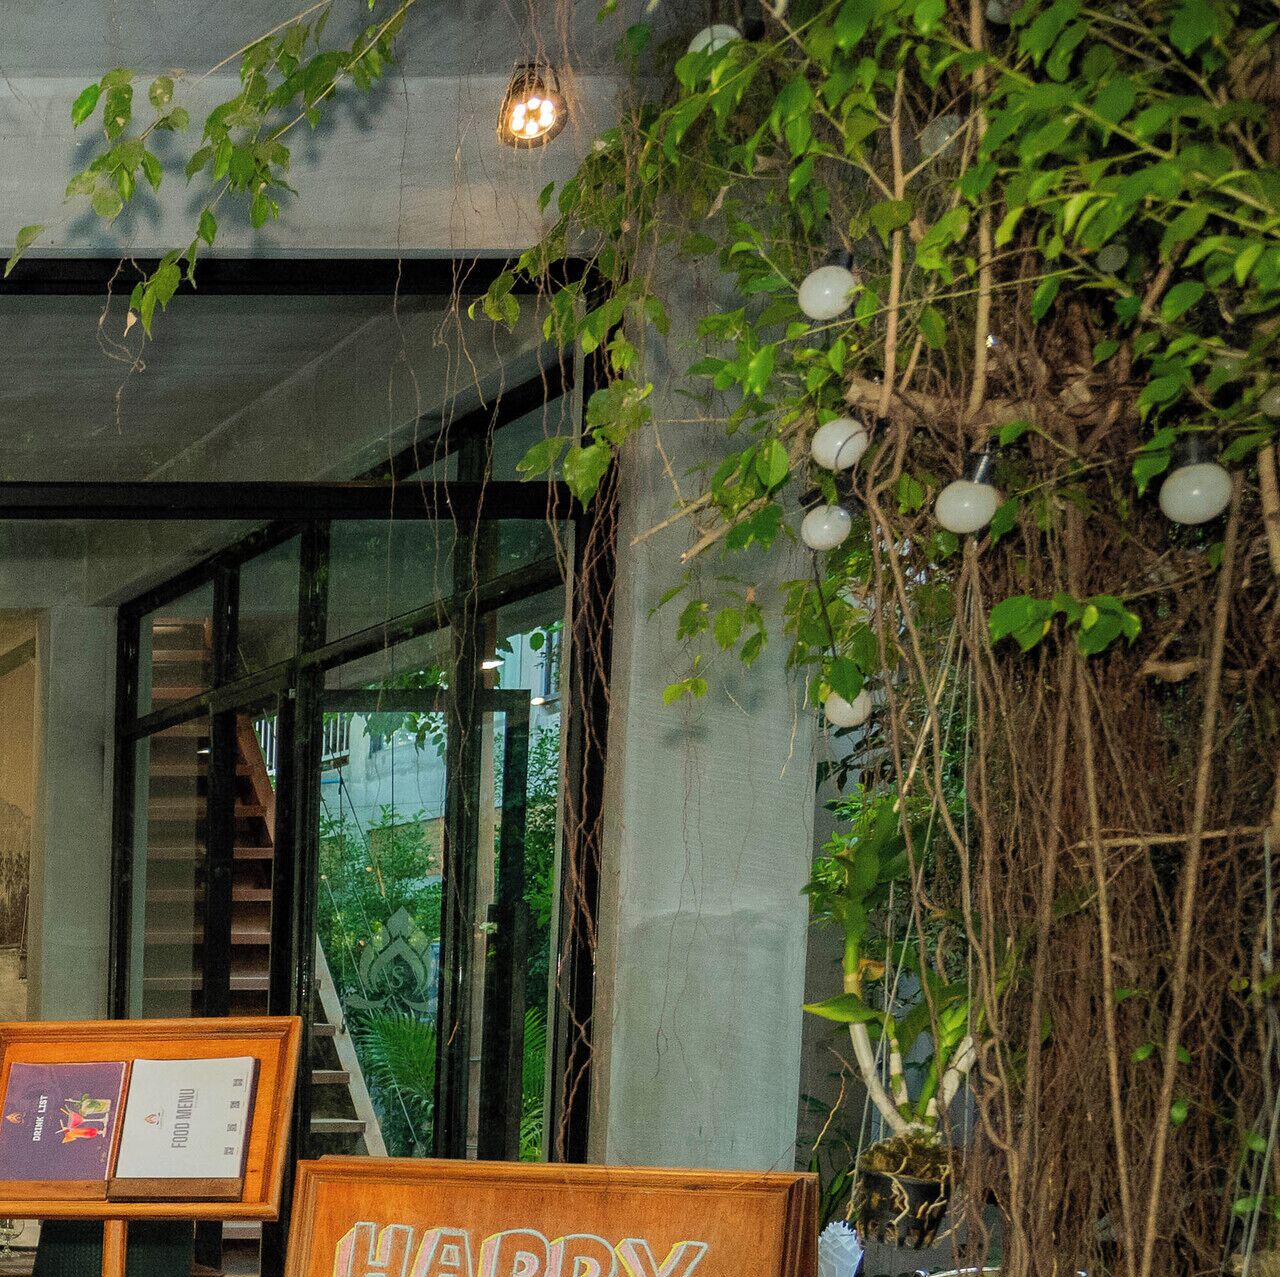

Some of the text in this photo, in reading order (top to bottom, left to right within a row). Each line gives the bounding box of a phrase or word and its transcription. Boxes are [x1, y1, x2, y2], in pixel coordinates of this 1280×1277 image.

[33, 1095, 49, 1141] DRINK LIST
[171, 1088, 195, 1149] FOOD MENU
